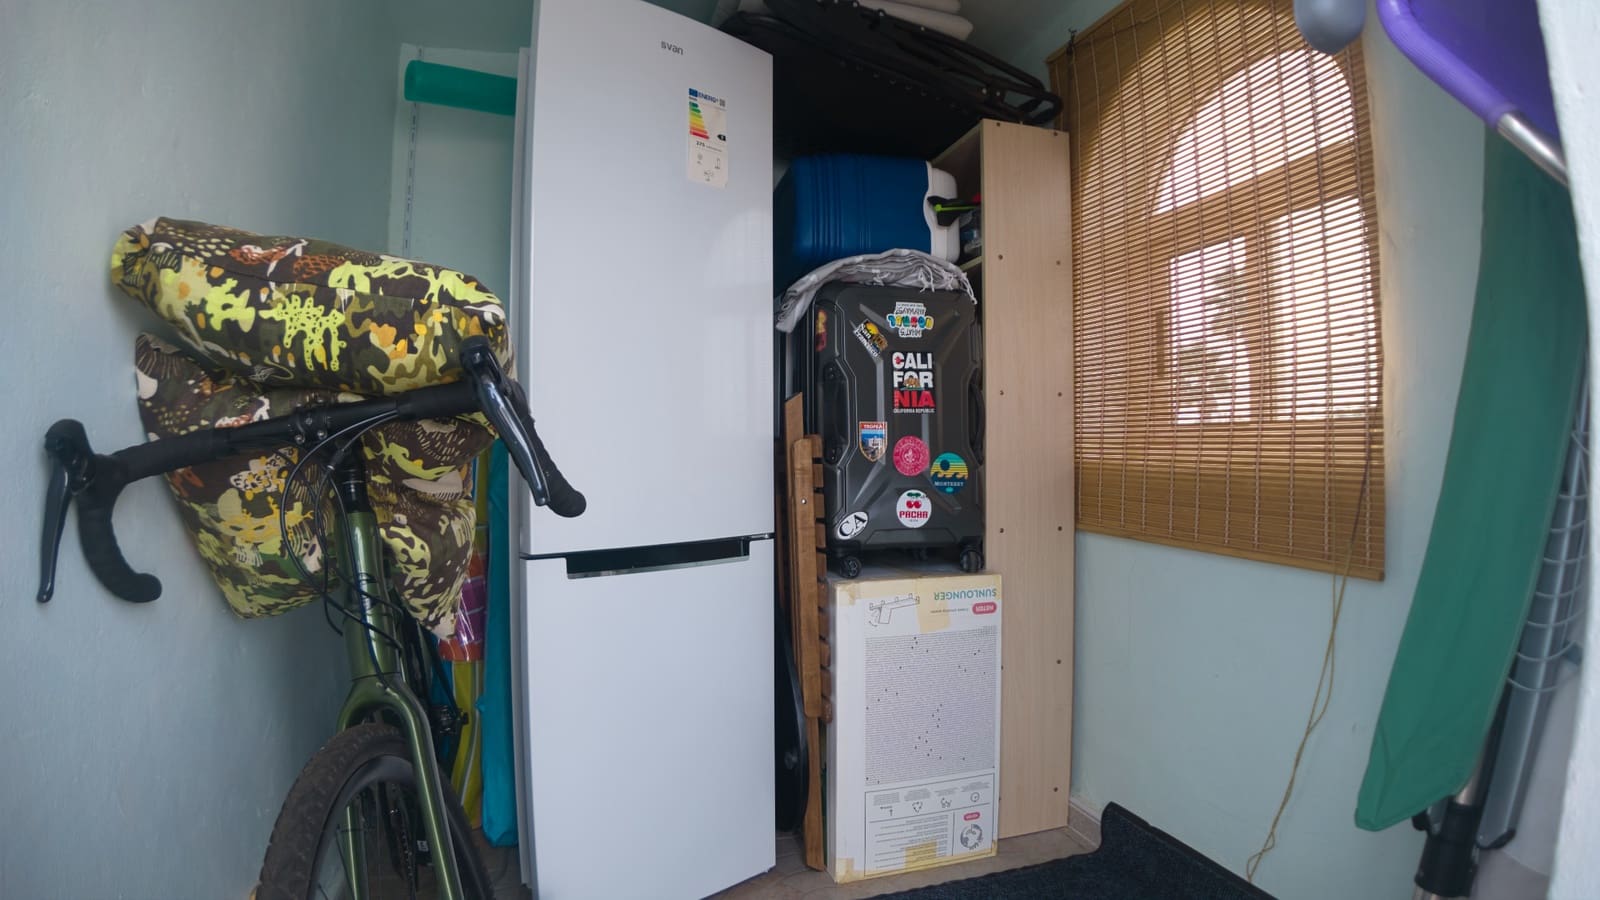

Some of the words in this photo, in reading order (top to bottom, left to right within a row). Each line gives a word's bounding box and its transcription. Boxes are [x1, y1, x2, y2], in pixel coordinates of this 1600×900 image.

[661, 41, 684, 55] svan
[859, 322, 872, 339] San
[892, 352, 933, 369] CALI
[893, 371, 934, 388] FOR
[894, 390, 935, 407] NIA
[899, 511, 929, 519] PACHA
[839, 515, 867, 537] CA
[934, 588, 997, 600] SUNLOUNGER
